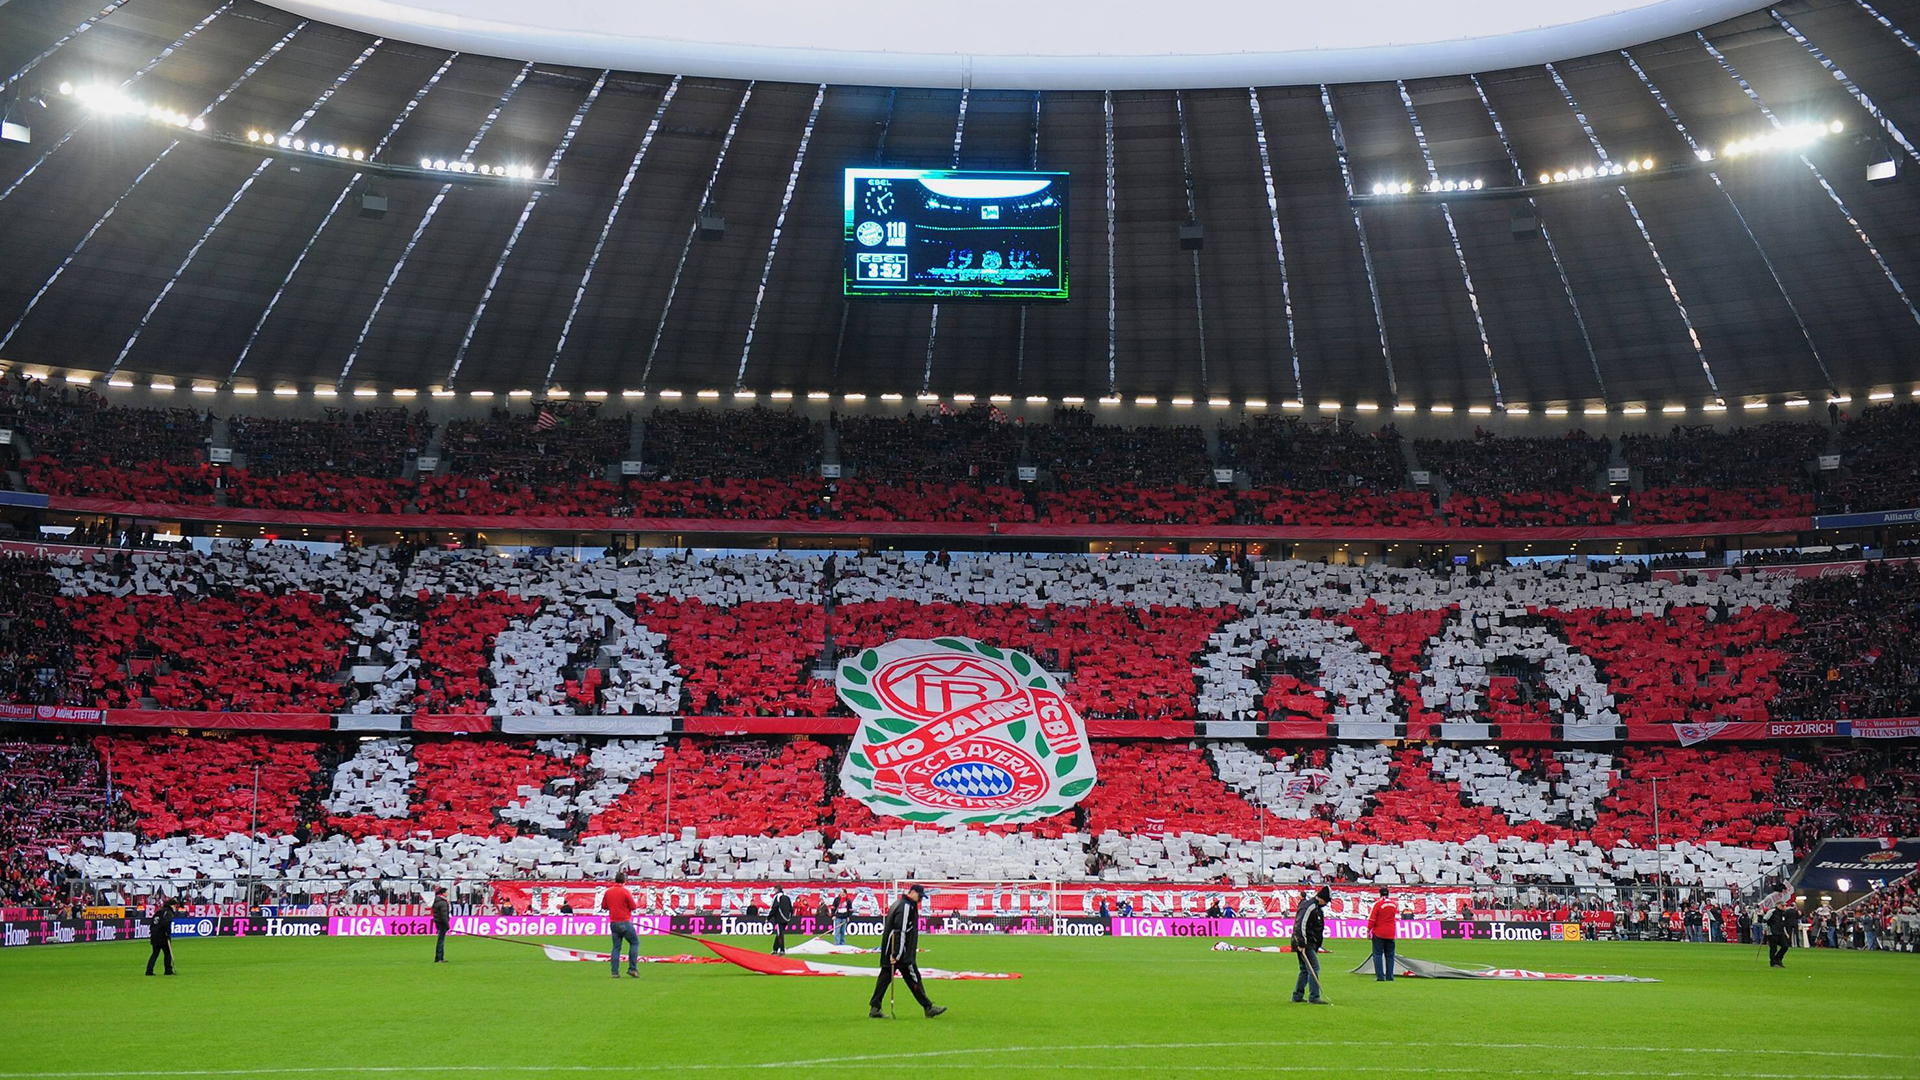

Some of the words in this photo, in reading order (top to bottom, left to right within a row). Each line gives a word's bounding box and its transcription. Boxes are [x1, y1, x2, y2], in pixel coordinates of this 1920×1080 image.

[886, 222, 906, 237] 110
[868, 264, 901, 278] 3:52
[1884, 513, 1912, 522] Allianz
[1036, 696, 1068, 735] FCB
[874, 738, 925, 766] 110
[929, 696, 1033, 742] JAHRE
[1771, 725, 1792, 735] BFC
[1794, 723, 1834, 734] ZÜRICH
[912, 757, 946, 777] F.C.
[945, 743, 1036, 778] BAYERN
[907, 782, 1018, 808] MÜNCHEN
[1816, 861, 1918, 870] PAULANER
[966, 883, 1054, 917] FÜR
[5, 923, 29, 946] Home
[53, 921, 75, 942] Home
[96, 920, 116, 940] Home
[265, 918, 321, 936] Home
[337, 917, 386, 936] LIGA
[391, 919, 438, 935] total
[451, 917, 491, 935] Alle
[495, 917, 557, 935] Spiele
[561, 917, 596, 935] live
[720, 917, 774, 935] Home
[1053, 918, 1105, 936] Home
[1121, 919, 1167, 936] LIGA
[1171, 921, 1219, 936] total!
[1230, 920, 1267, 937] Alle
[1336, 921, 1367, 938] live
[1397, 922, 1432, 938] HD!
[1490, 923, 1542, 940] Home
